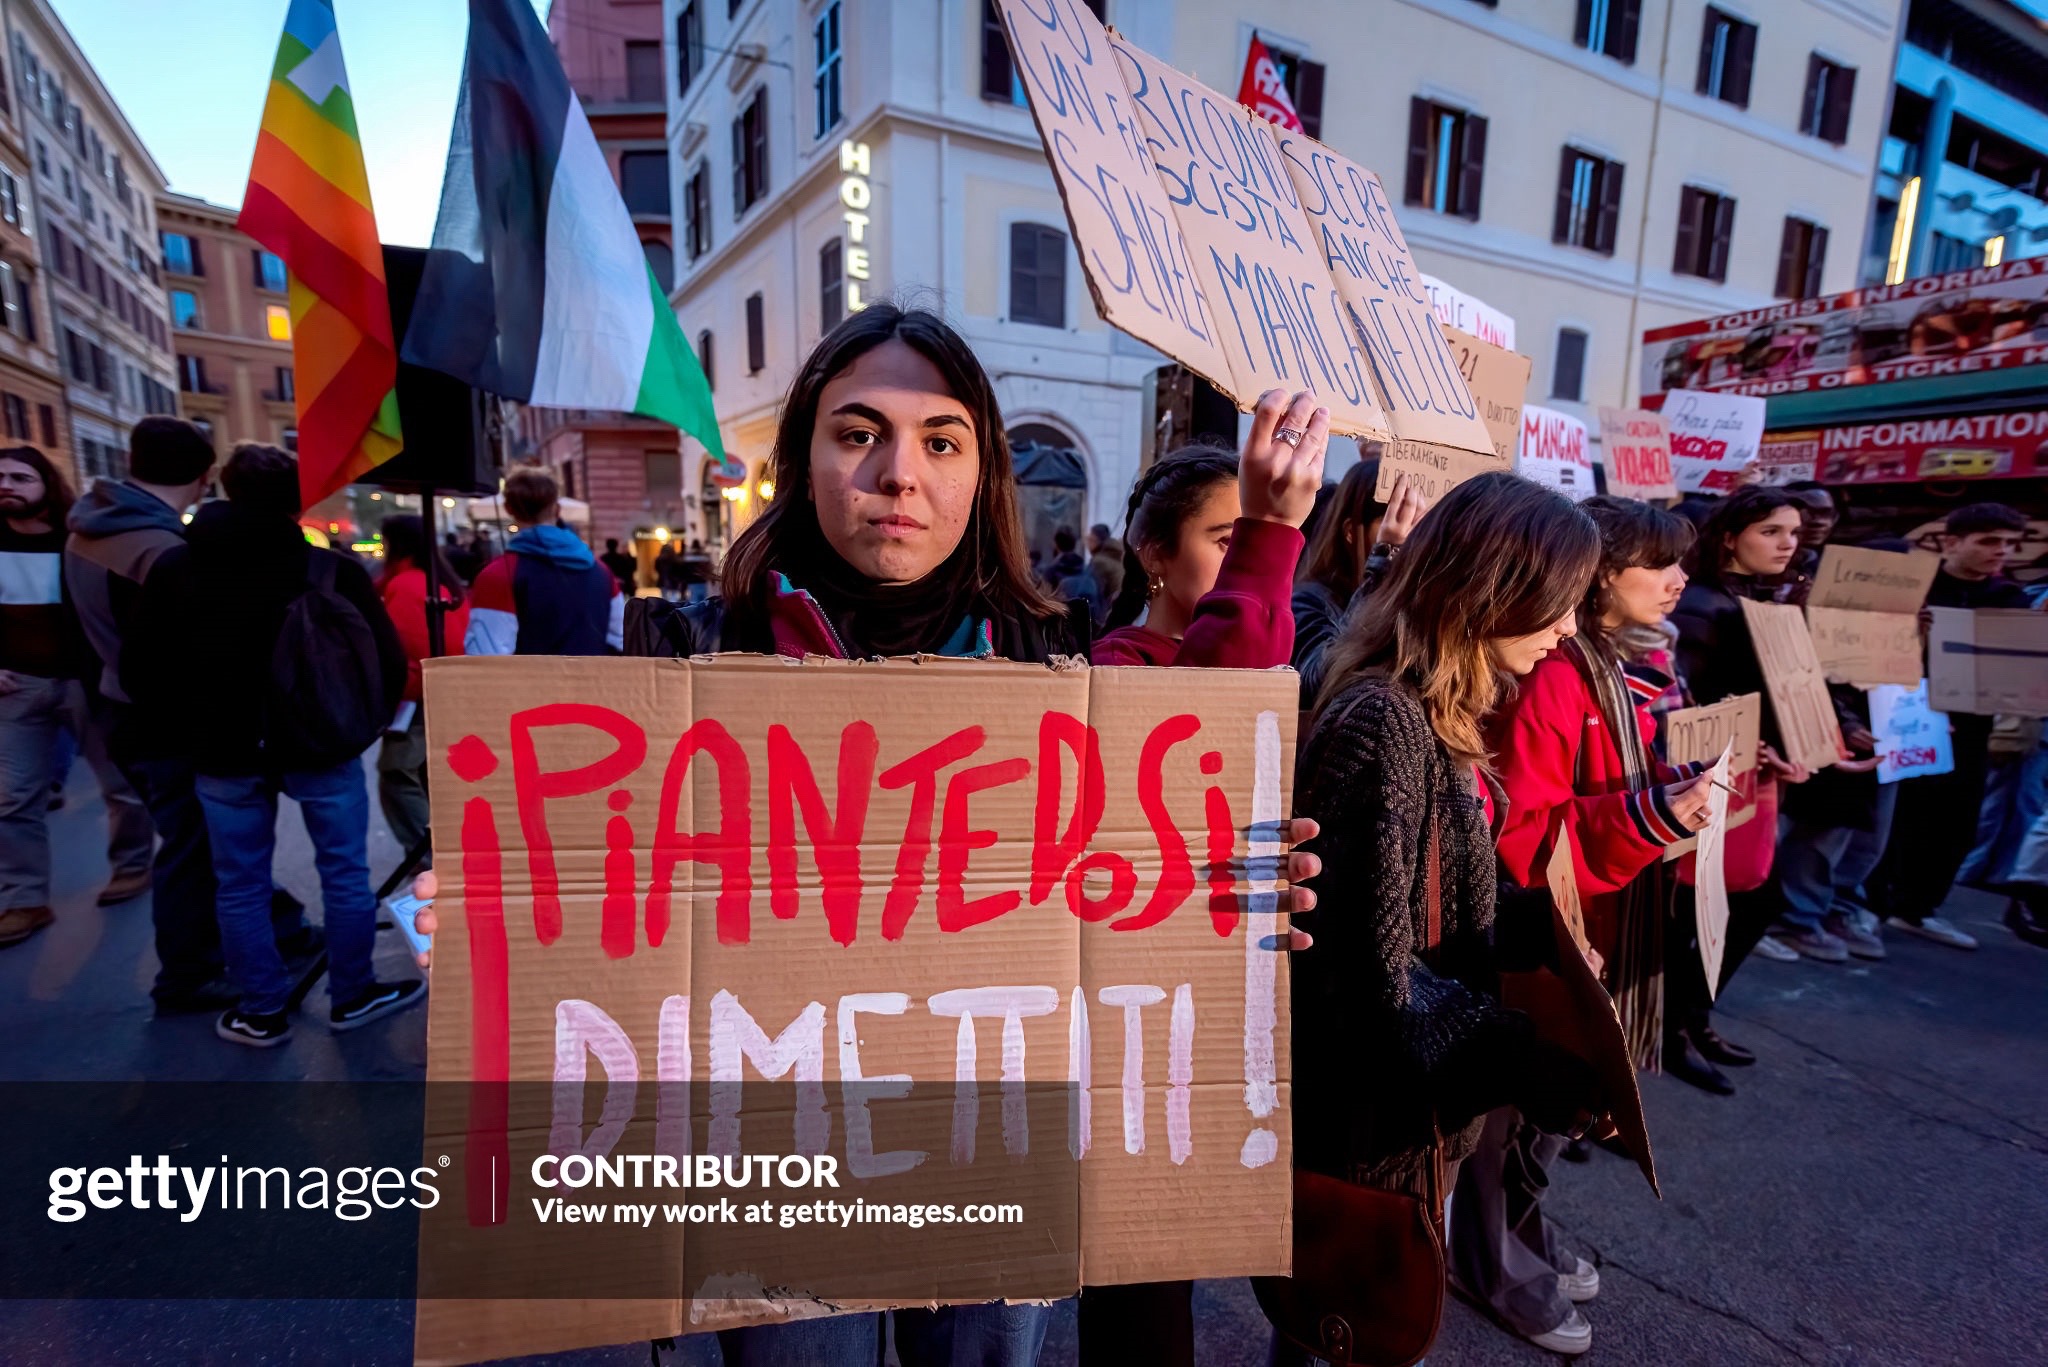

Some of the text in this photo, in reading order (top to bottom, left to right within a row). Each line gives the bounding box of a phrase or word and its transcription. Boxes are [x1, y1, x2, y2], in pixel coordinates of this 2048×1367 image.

[840, 138, 871, 313] HOTEL
[1007, 10, 1105, 136] UN
[1105, 91, 1304, 255] FASCISTA
[1321, 222, 1424, 304] ANCHE
[1111, 44, 1406, 254] RICONOSCERE
[1208, 244, 1476, 421] MANGANELLO
[1705, 295, 1837, 332] TOURIST
[1872, 351, 2012, 381] TICKET
[1385, 442, 1448, 472] LIBERAMENTE
